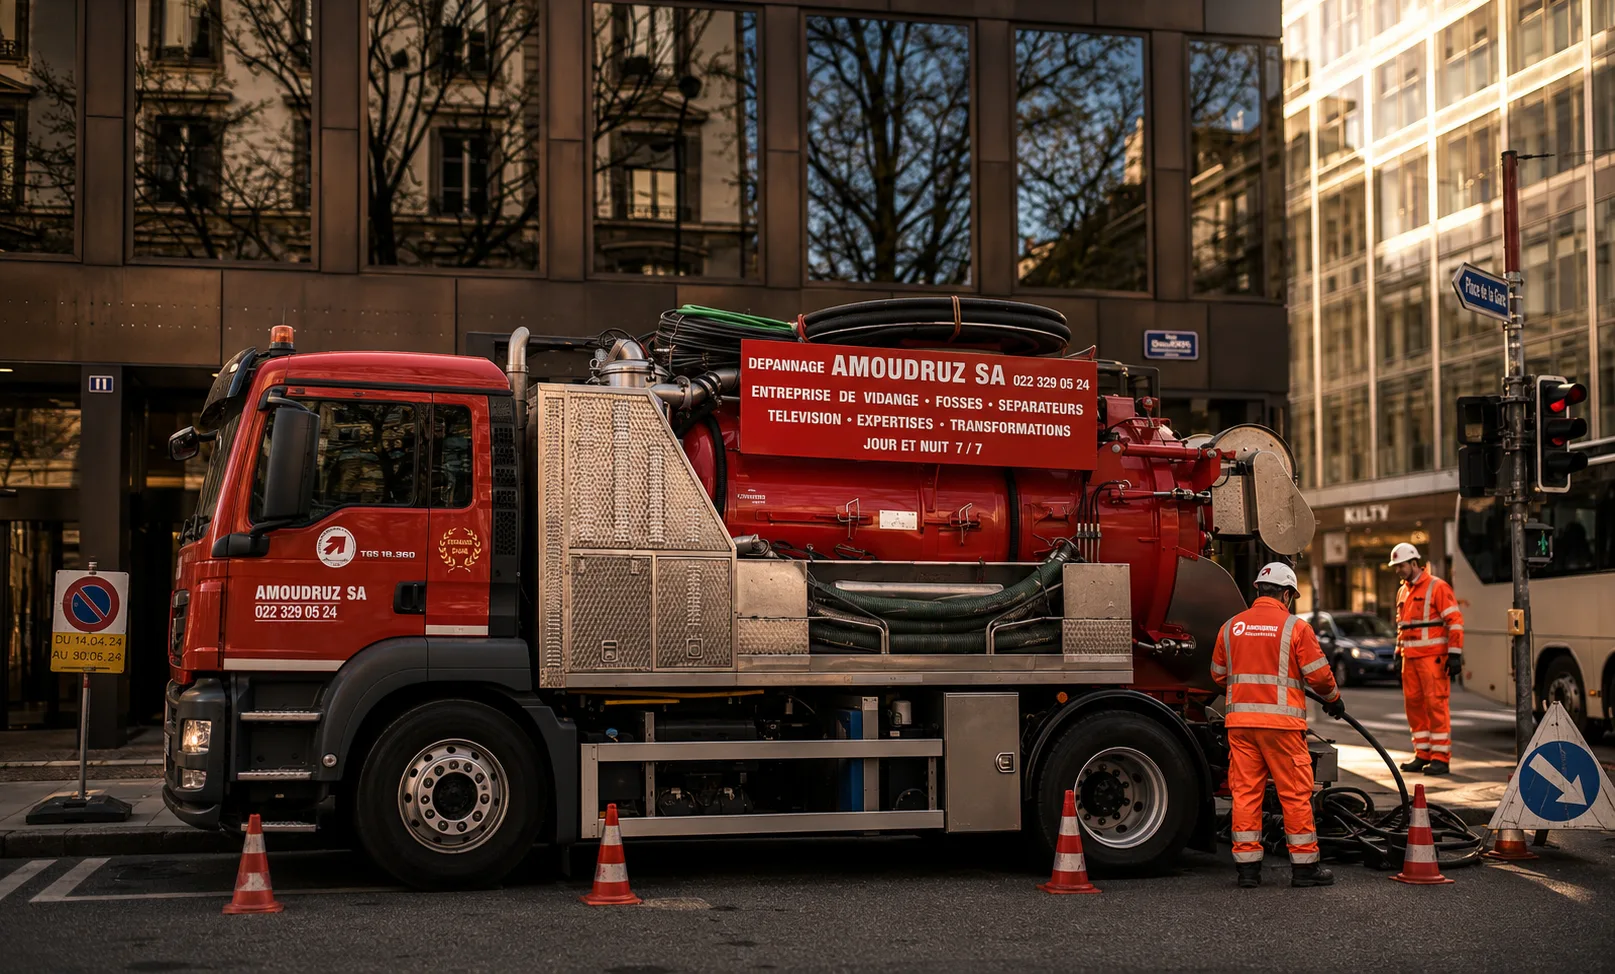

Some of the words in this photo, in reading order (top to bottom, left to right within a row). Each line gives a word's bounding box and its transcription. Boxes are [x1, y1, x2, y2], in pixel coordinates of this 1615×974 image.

[1465, 276, 1480, 298] Place
[1480, 284, 1487, 300] de
[1488, 285, 1494, 303] la
[1494, 288, 1506, 308] Gare
[748, 357, 825, 374] DEPANNAGE
[831, 354, 966, 384] AMOUDRUZ
[975, 362, 1006, 386] SA
[1013, 374, 1034, 388] 022
[1036, 376, 1057, 389] 329
[1059, 378, 1074, 390] 05
[1076, 379, 1090, 391] 24
[95, 378, 107, 390] 11
[751, 385, 831, 402] ENTREPRISE
[839, 390, 856, 403] DE
[863, 392, 919, 407] VIDANGE
[935, 395, 983, 410] FOSSES
[998, 399, 1084, 416] SEPARATEURS
[767, 409, 842, 425] TELEVISION
[857, 413, 934, 430] EXPERTISES
[949, 418, 1071, 437] TRANSFORMATIONS
[863, 437, 897, 451] JOUR
[901, 439, 917, 452] ET
[920, 440, 950, 453] NUIT
[1344, 504, 1390, 524] KILTY
[360, 550, 379, 558] TGS
[381, 551, 416, 559] 18.360
[255, 585, 341, 601] AMOUDRUZ
[346, 586, 367, 601] SA
[255, 605, 277, 619] 022
[280, 605, 303, 619] 329
[304, 605, 320, 619] 05
[322, 605, 338, 619] 24
[55, 635, 71, 645] DU
[75, 637, 122, 647] 14.04.24
[52, 651, 68, 660] AU
